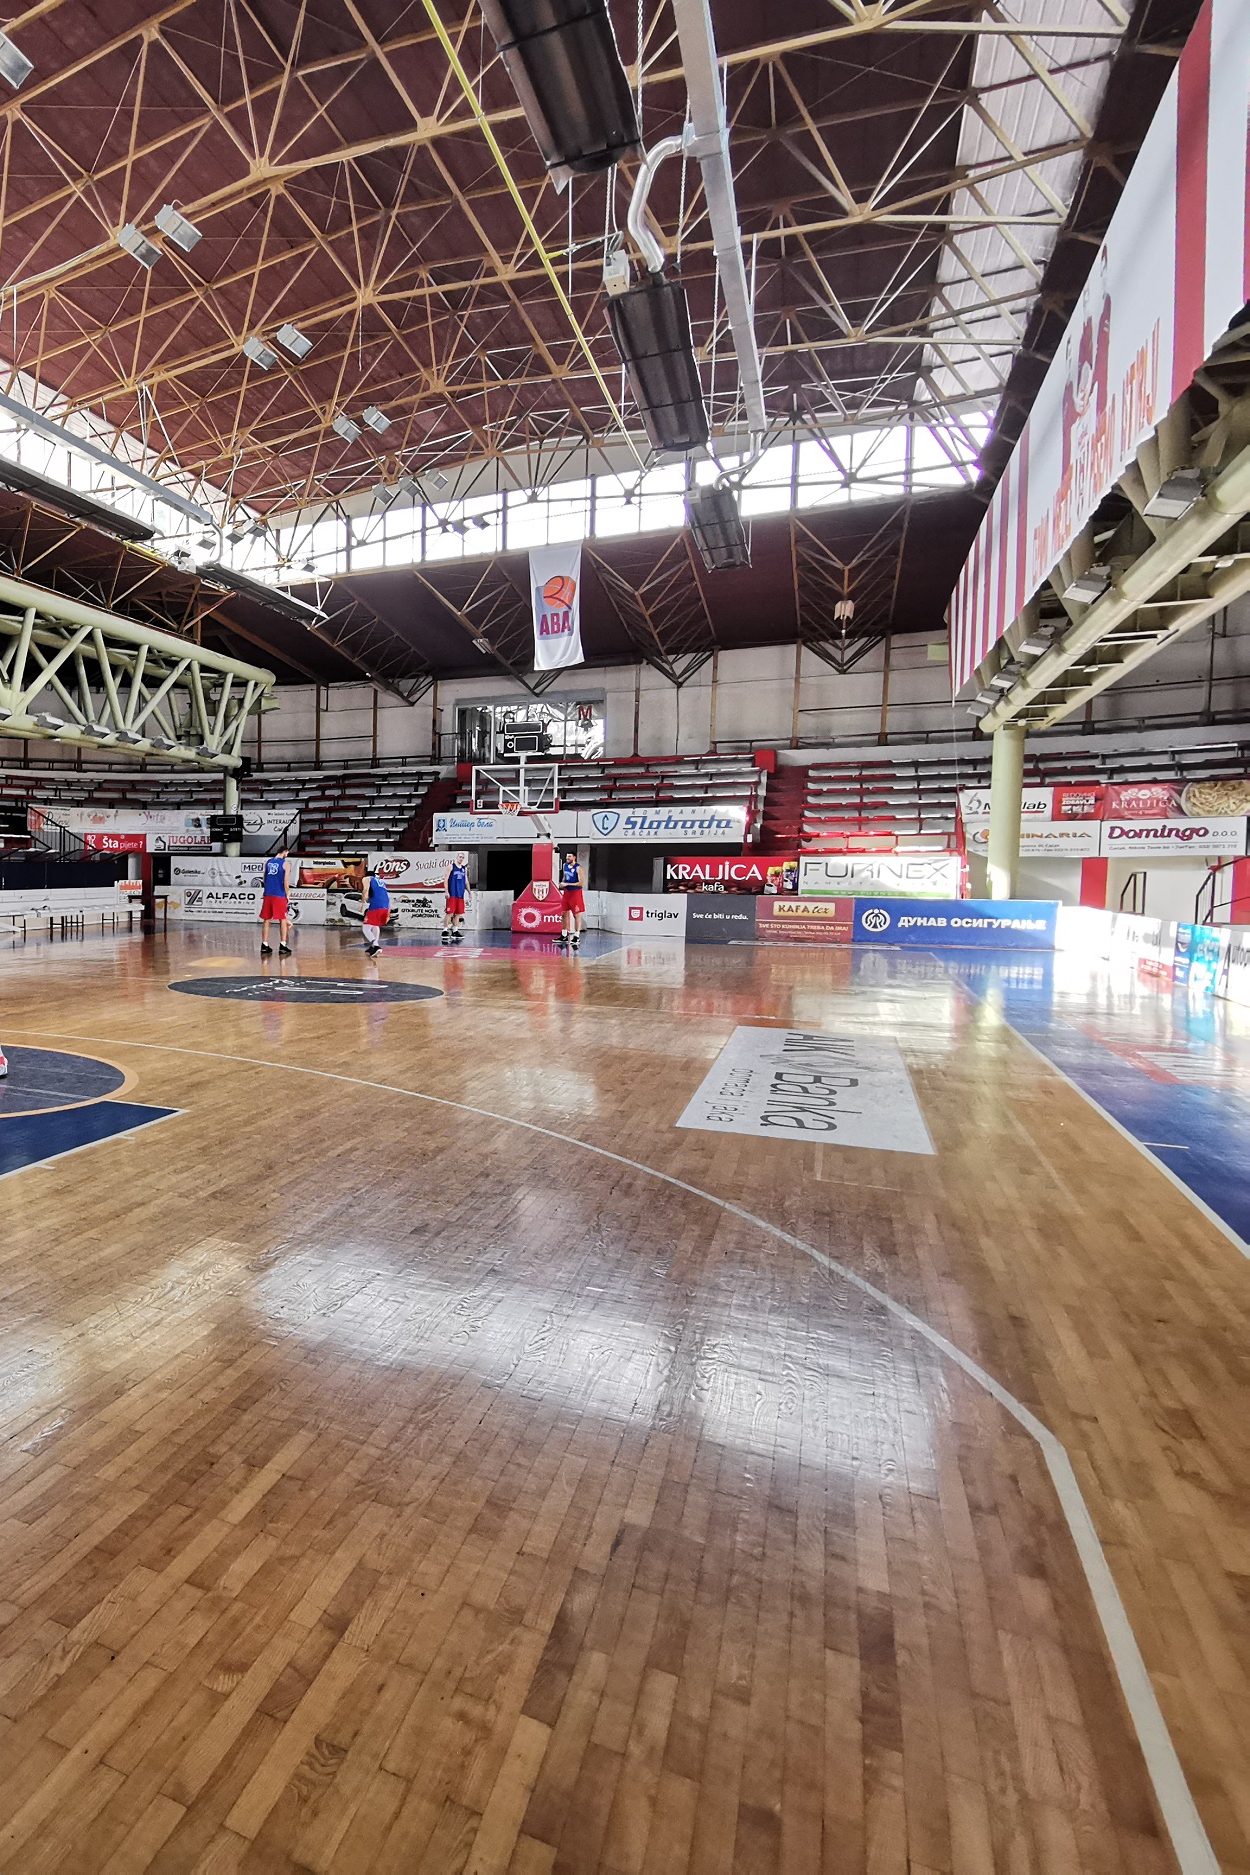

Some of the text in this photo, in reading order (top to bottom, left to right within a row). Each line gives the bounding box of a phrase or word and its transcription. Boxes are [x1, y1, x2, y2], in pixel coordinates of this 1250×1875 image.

[539, 610, 571, 636] ABA
[622, 814, 733, 830] Sloboda
[1107, 824, 1209, 841] Domingo
[102, 836, 119, 849] Šta
[375, 860, 408, 874] Pons
[415, 859, 438, 870] Svaki
[666, 861, 763, 881] KRALJICA
[702, 882, 725, 892] kafa
[206, 892, 256, 901] ALFACO
[778, 901, 810, 914] KAFA
[646, 910, 679, 921] triglav
[898, 916, 1047, 930] ДУНАВ ОСИГУРАЊЕ
[781, 1032, 856, 1057] AIK
[759, 1071, 863, 1132] Banka
